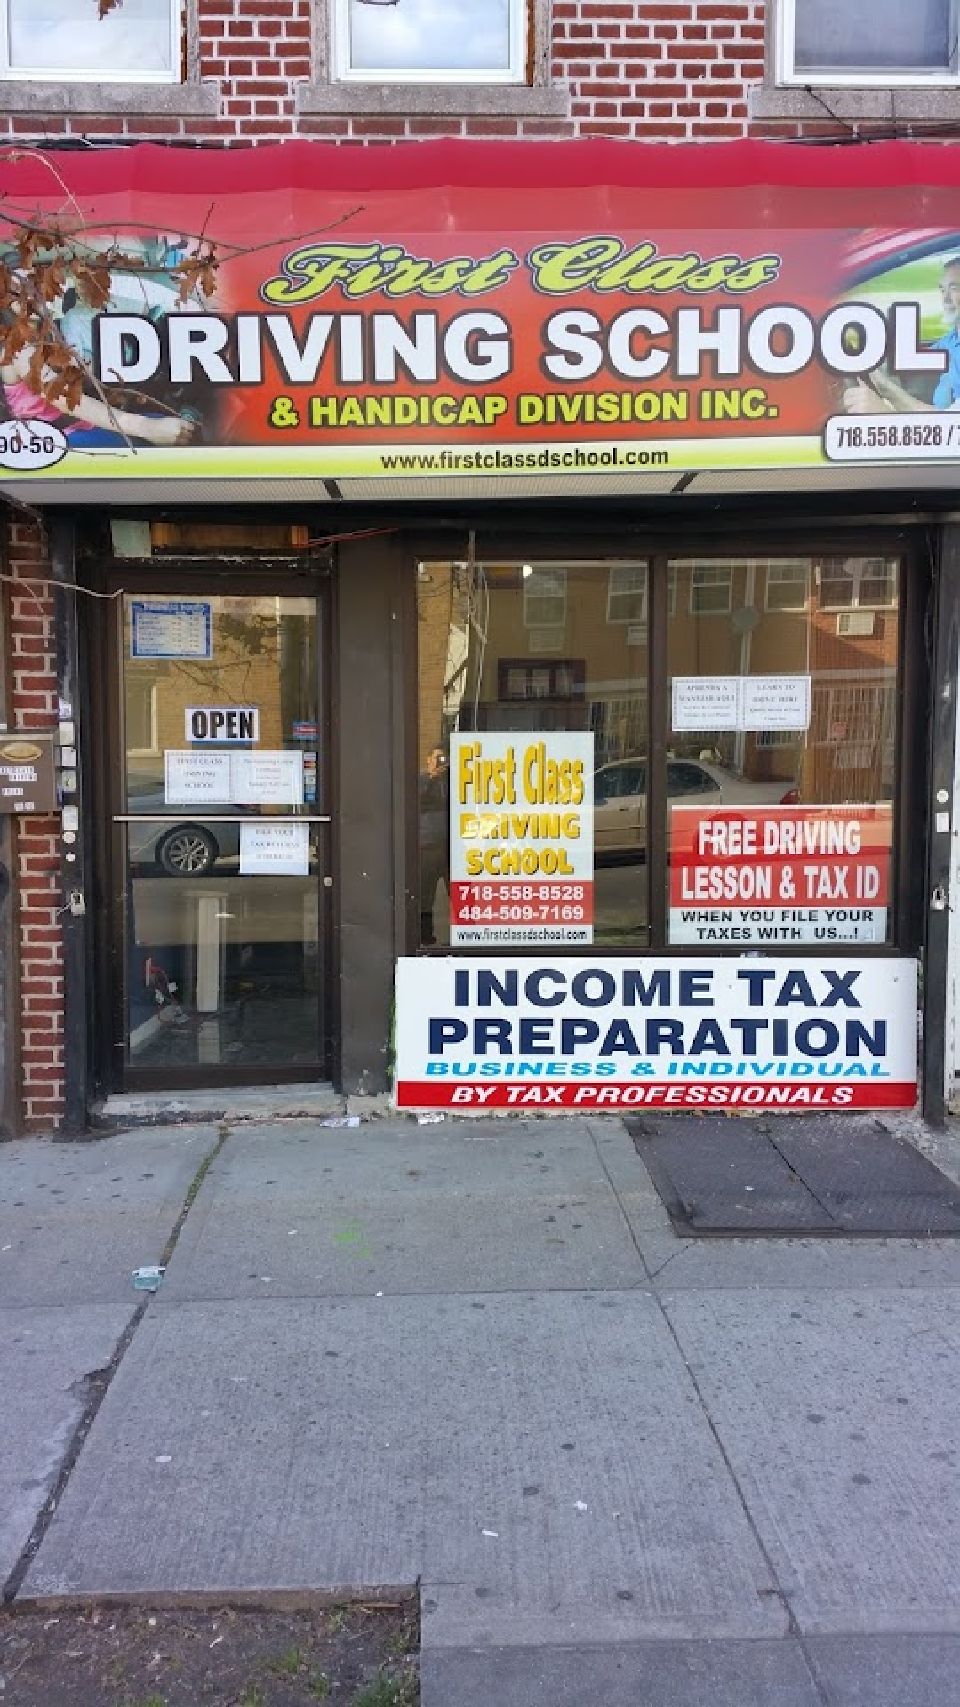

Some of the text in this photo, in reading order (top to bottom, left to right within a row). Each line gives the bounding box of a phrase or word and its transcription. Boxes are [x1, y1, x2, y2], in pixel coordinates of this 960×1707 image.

[261, 235, 781, 306] First Class
[98, 303, 947, 385] DRIVING SCHOOL
[270, 388, 779, 427] & HANDICAP DIVISION INC.
[837, 425, 943, 448] 718.558.8528
[380, 448, 669, 470] www.firstclassdschool.com
[192, 711, 255, 739] OPEN
[458, 740, 585, 805] First Class
[459, 813, 581, 839] DRIVING
[699, 821, 861, 855] FREE DRIVING
[466, 848, 574, 875] SCHOOL
[458, 885, 585, 901] 718-558-8528
[682, 866, 880, 900] LESSON & TAX ID
[458, 904, 585, 920] 484-509-7169
[681, 910, 873, 922] WHEN YOU FILE YOUR
[696, 927, 858, 940] TAXES WITH US...!
[454, 968, 863, 1008] INCOME TAX
[428, 1018, 887, 1058] PREPARATION
[425, 1062, 891, 1076] BUSINESS & INDIVIDUAL
[451, 1085, 854, 1103] BY TAX PROFESSIONALS
